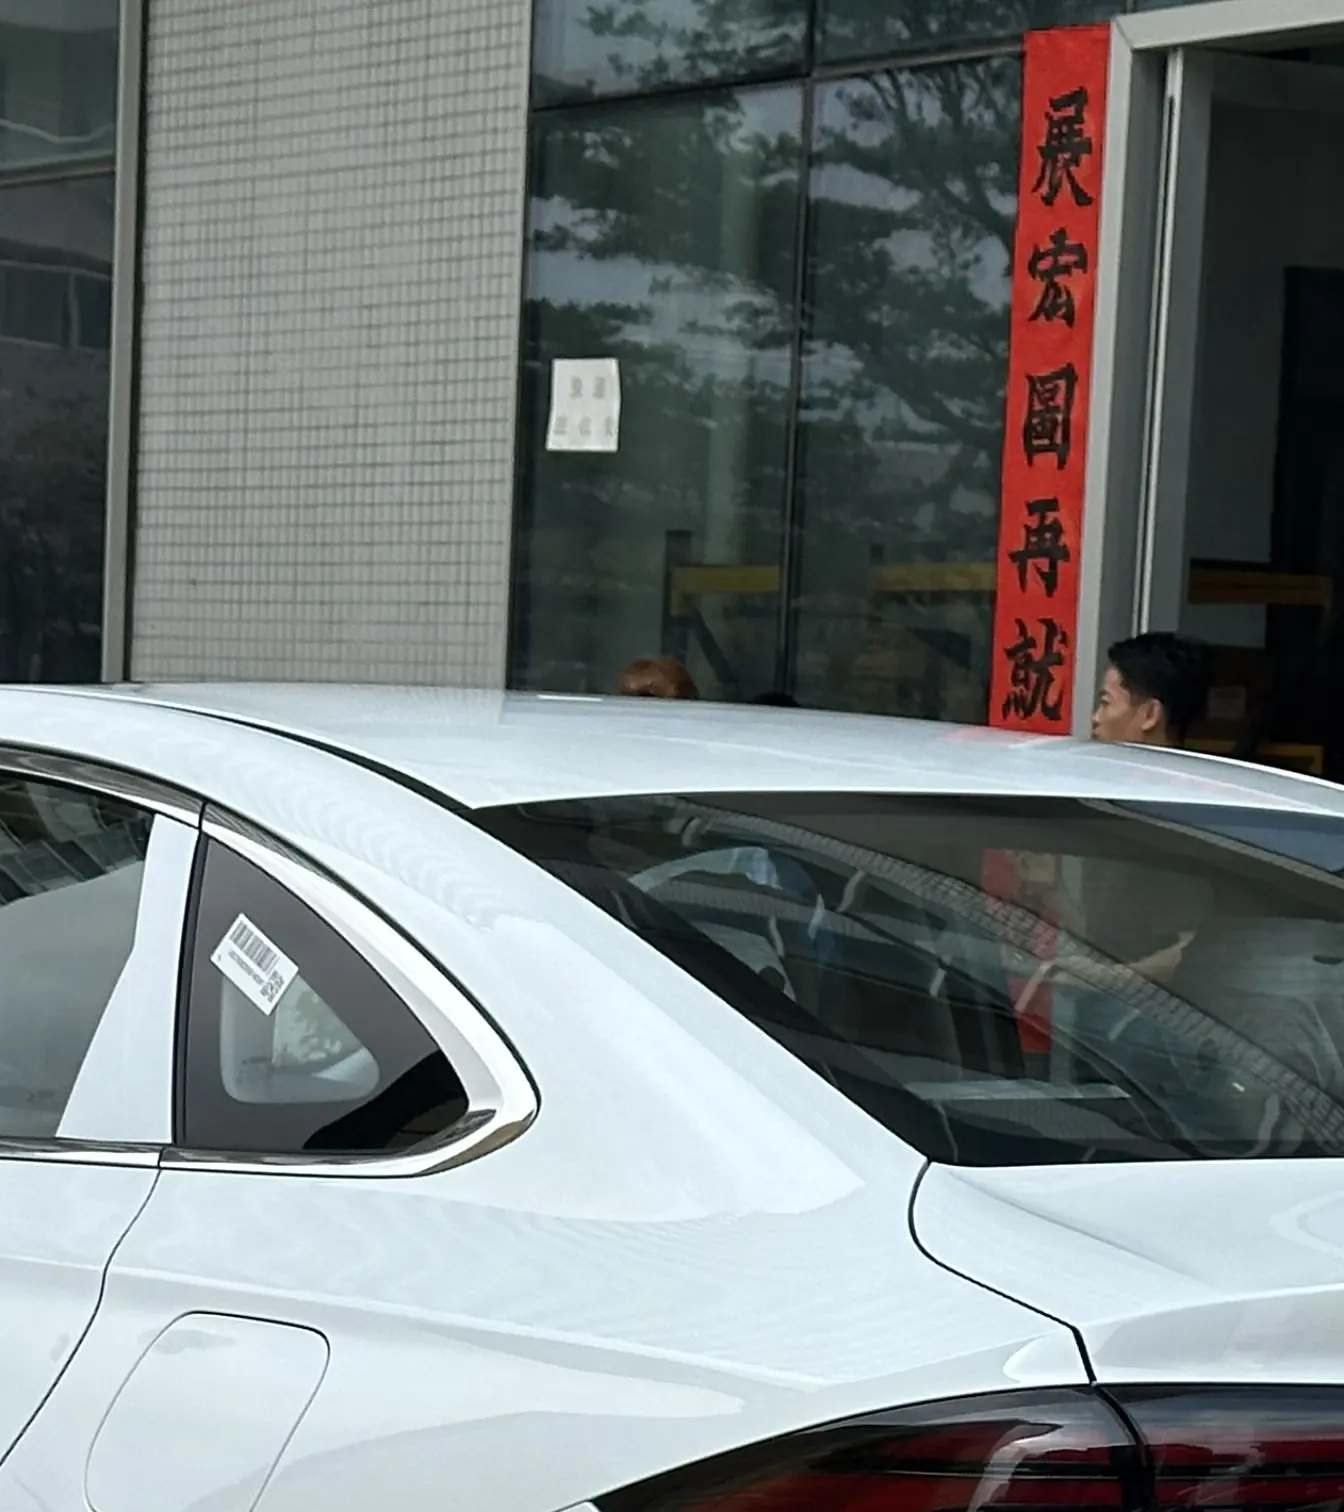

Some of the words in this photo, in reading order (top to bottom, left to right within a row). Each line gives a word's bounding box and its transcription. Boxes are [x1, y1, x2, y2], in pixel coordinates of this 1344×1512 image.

[1001, 86, 1094, 722] 展宏圖再就
